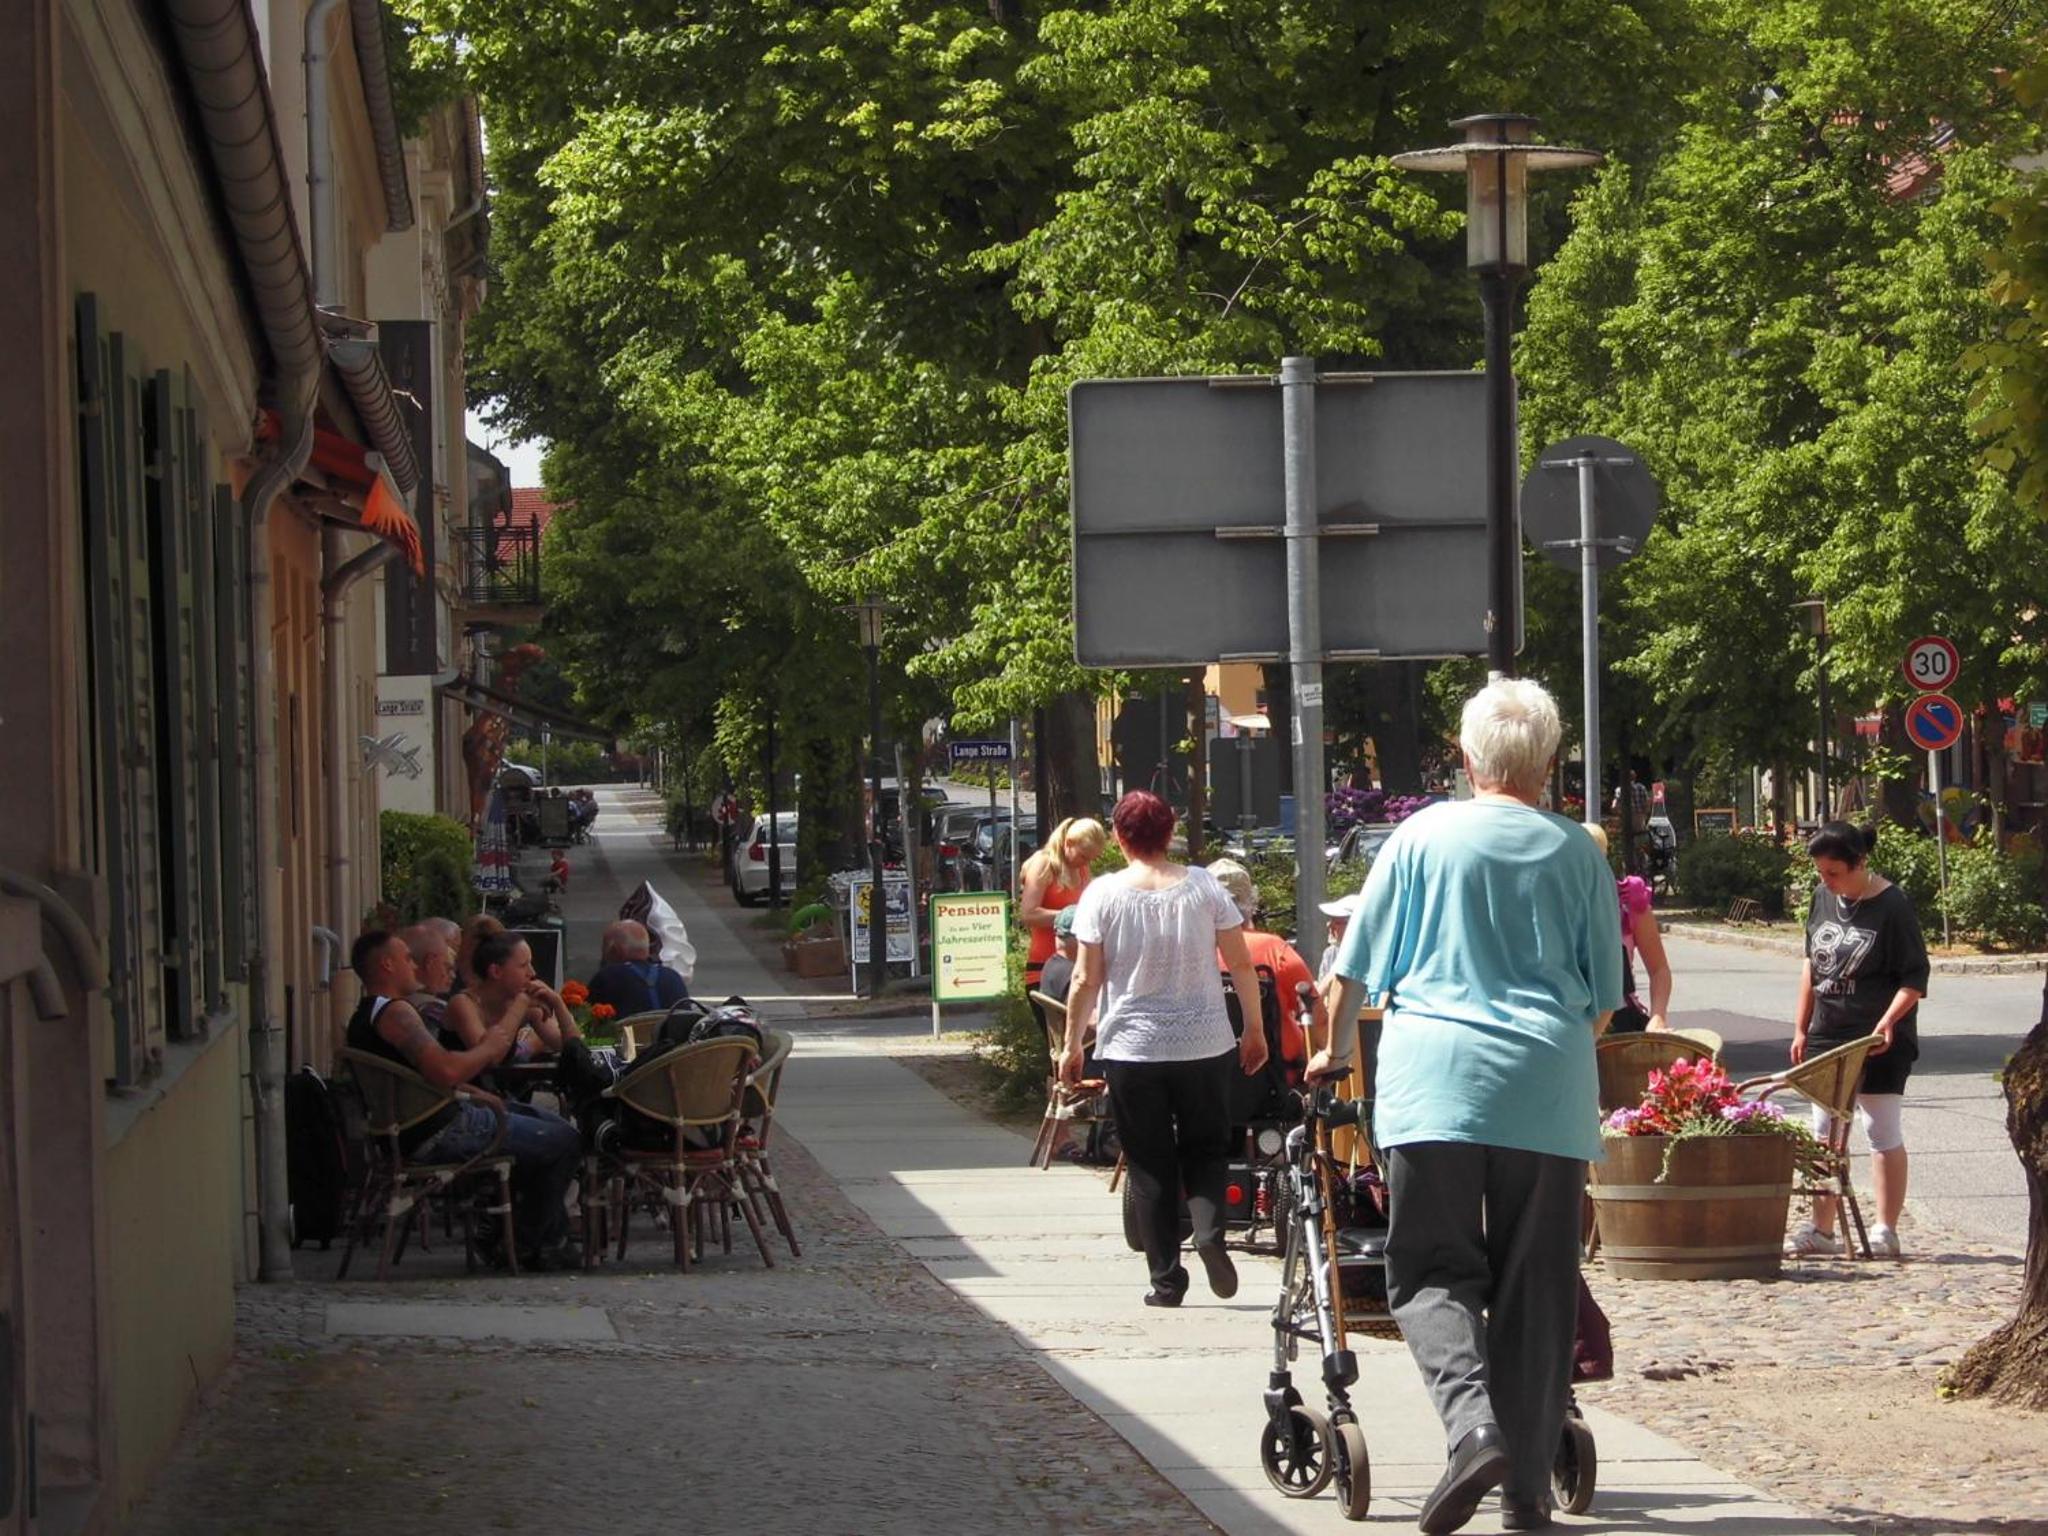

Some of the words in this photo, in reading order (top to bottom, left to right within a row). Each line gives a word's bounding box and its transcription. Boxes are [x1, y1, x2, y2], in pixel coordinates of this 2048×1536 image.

[1915, 651, 1946, 676] 30
[954, 745, 978, 757] Lange
[980, 745, 1007, 756] Straße
[937, 903, 1000, 917] Pension
[972, 922, 992, 930] Vier
[937, 934, 1003, 944] Jahreszeiten
[1811, 920, 1877, 978] 87
